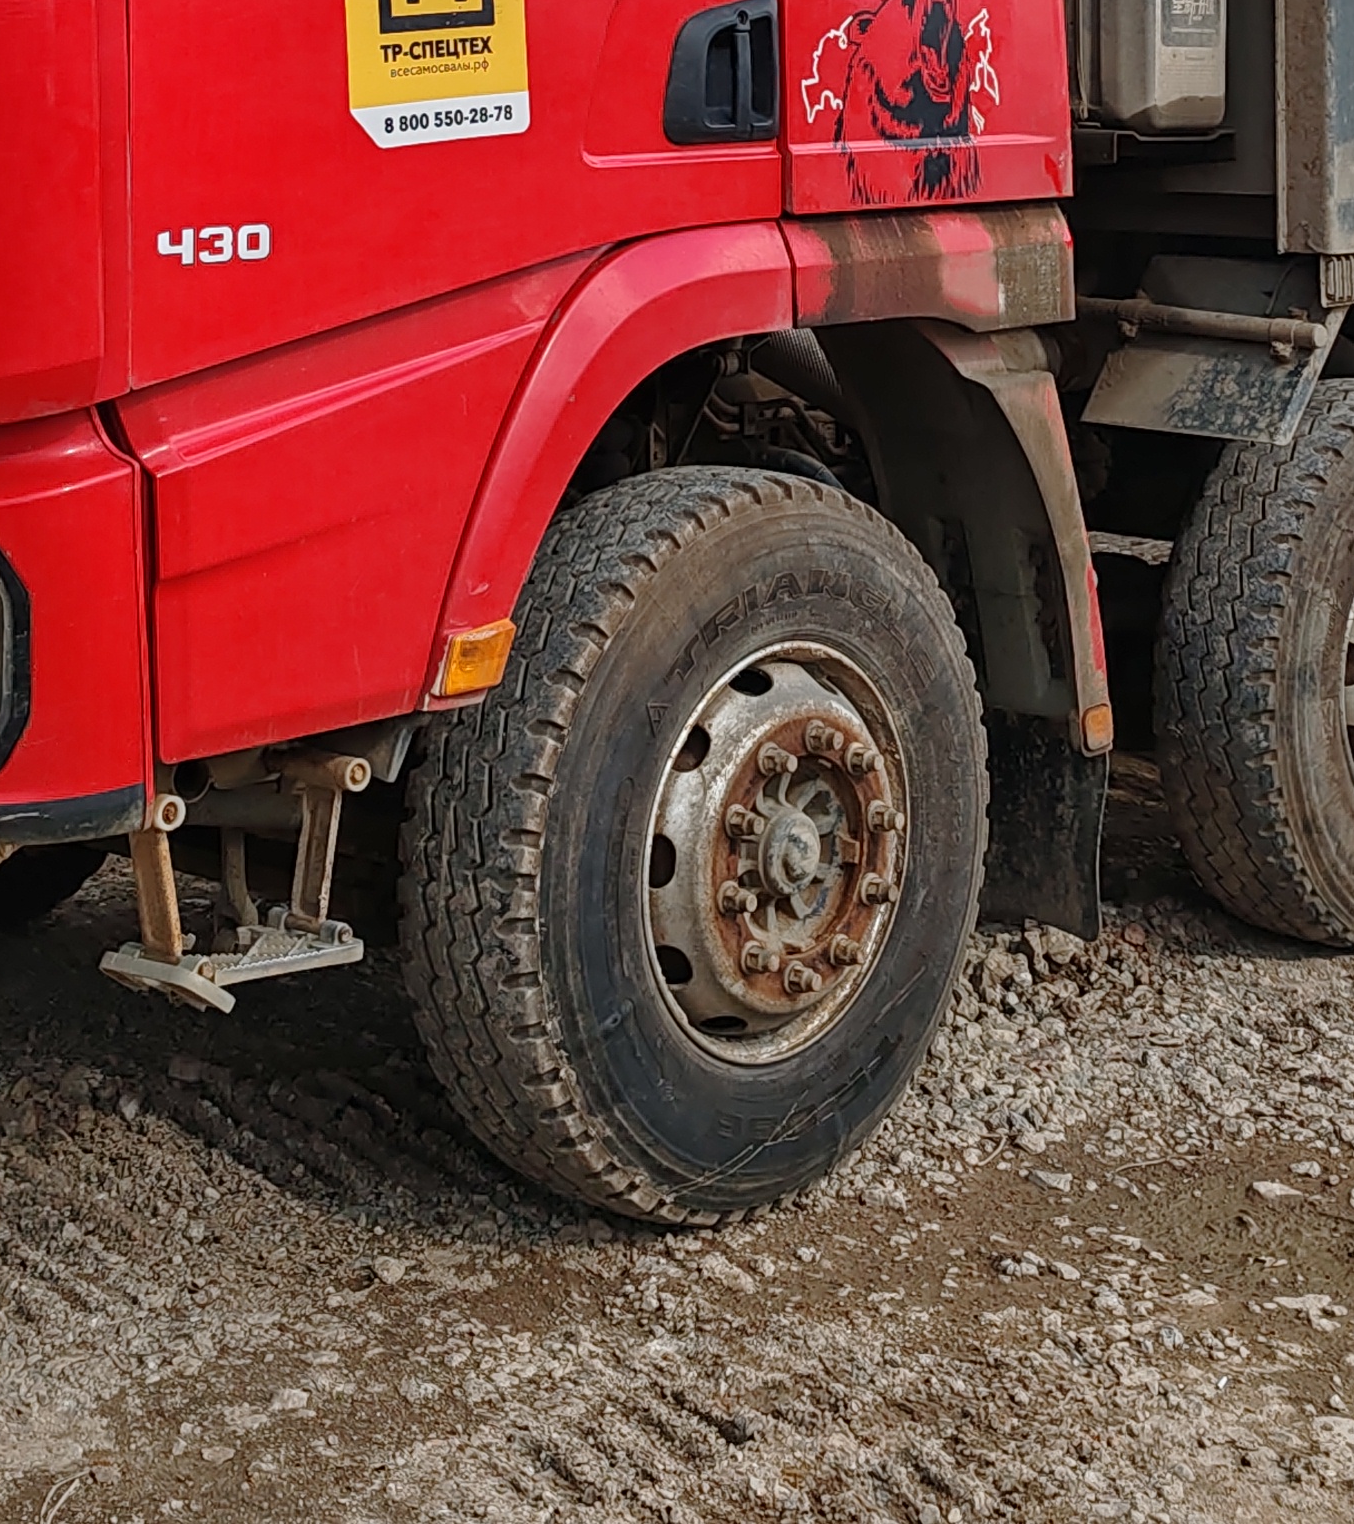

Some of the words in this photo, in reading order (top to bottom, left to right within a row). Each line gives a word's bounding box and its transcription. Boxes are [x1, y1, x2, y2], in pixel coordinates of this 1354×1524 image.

[380, 36, 493, 64] ТР-СПЕЦТЕХ
[390, 57, 490, 78] всесамосвалы.рф
[384, 117, 395, 134] 8
[398, 113, 430, 131] 800
[433, 104, 513, 127] 550-28-78
[156, 223, 272, 266] 430
